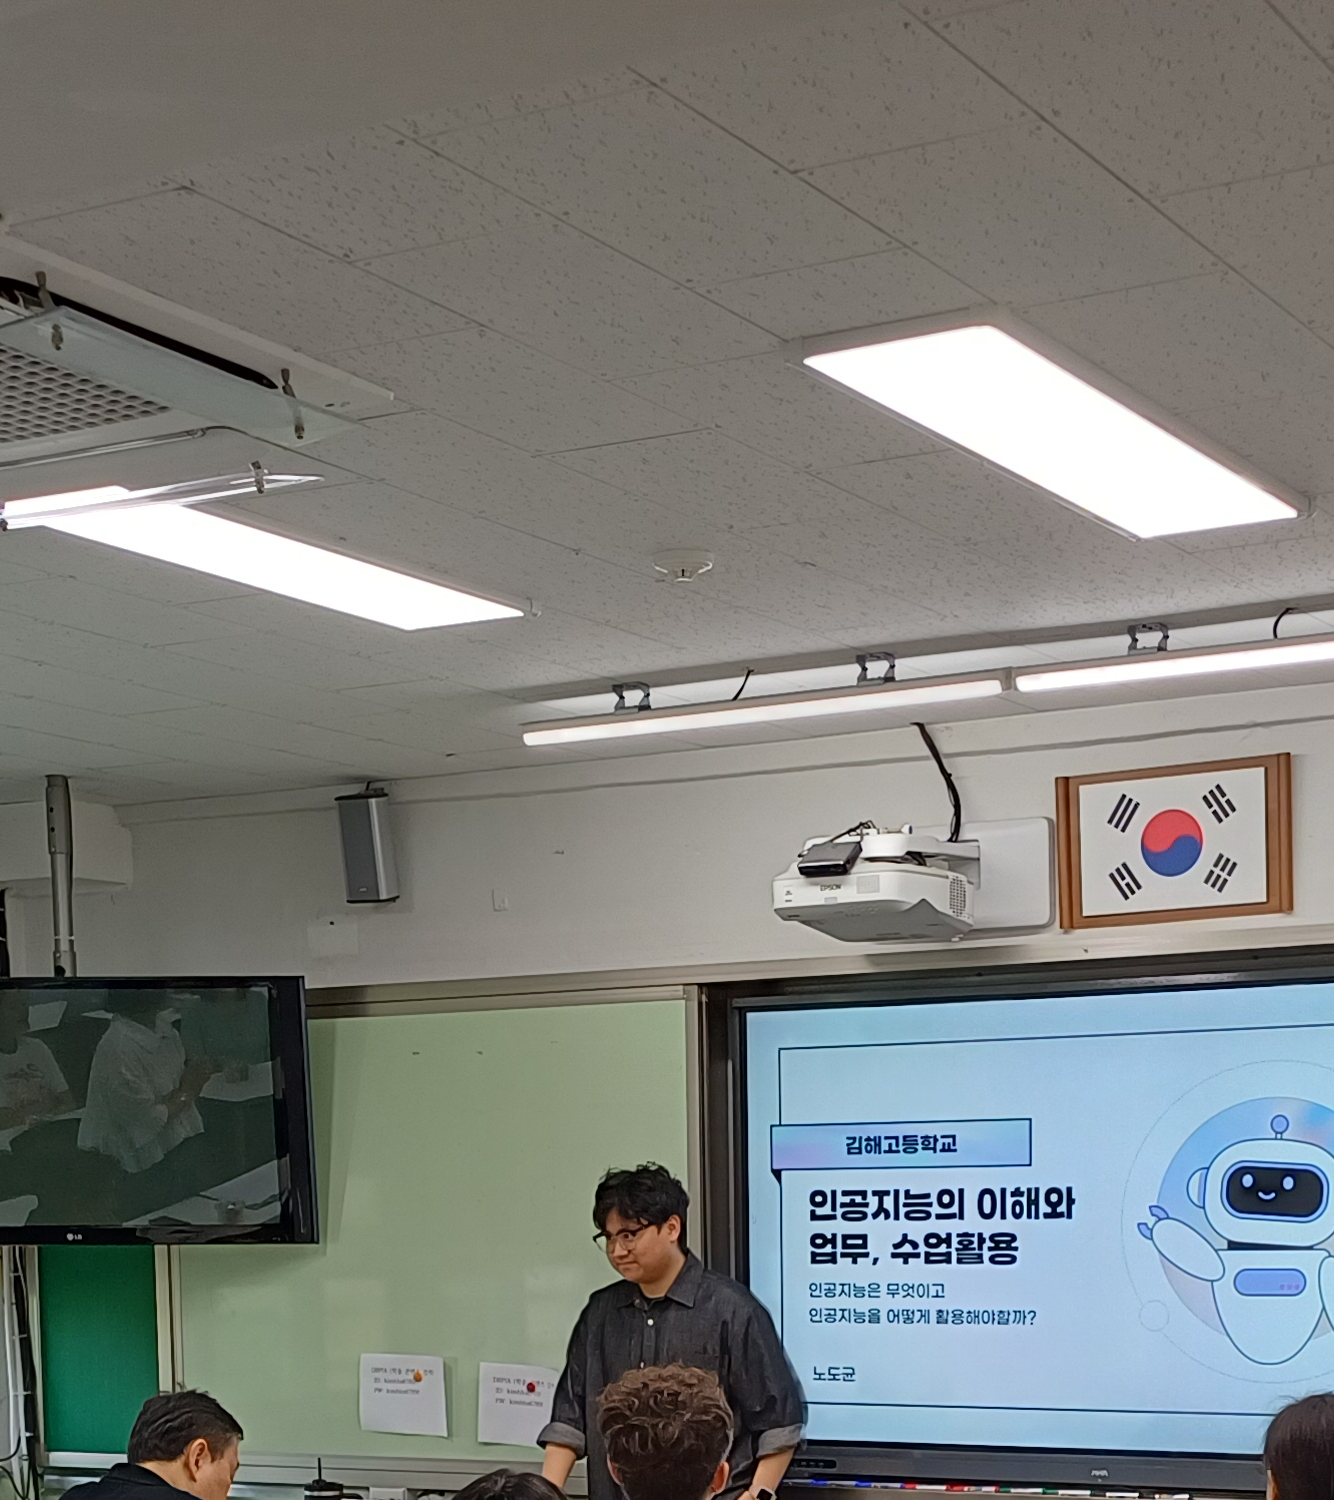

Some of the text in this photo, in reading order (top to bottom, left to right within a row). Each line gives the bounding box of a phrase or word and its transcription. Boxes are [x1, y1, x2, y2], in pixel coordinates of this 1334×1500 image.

[845, 1134, 958, 1155] 김해고등학교
[808, 1186, 1076, 1222] 인공지능의 이해와
[809, 1231, 1019, 1266] 업무, 수업활용
[808, 1282, 946, 1299] 인공지능은 무엇이고
[808, 1307, 1037, 1326] 인공지능을 어떻게 활용해야할까?
[812, 1365, 857, 1382] 노도균
